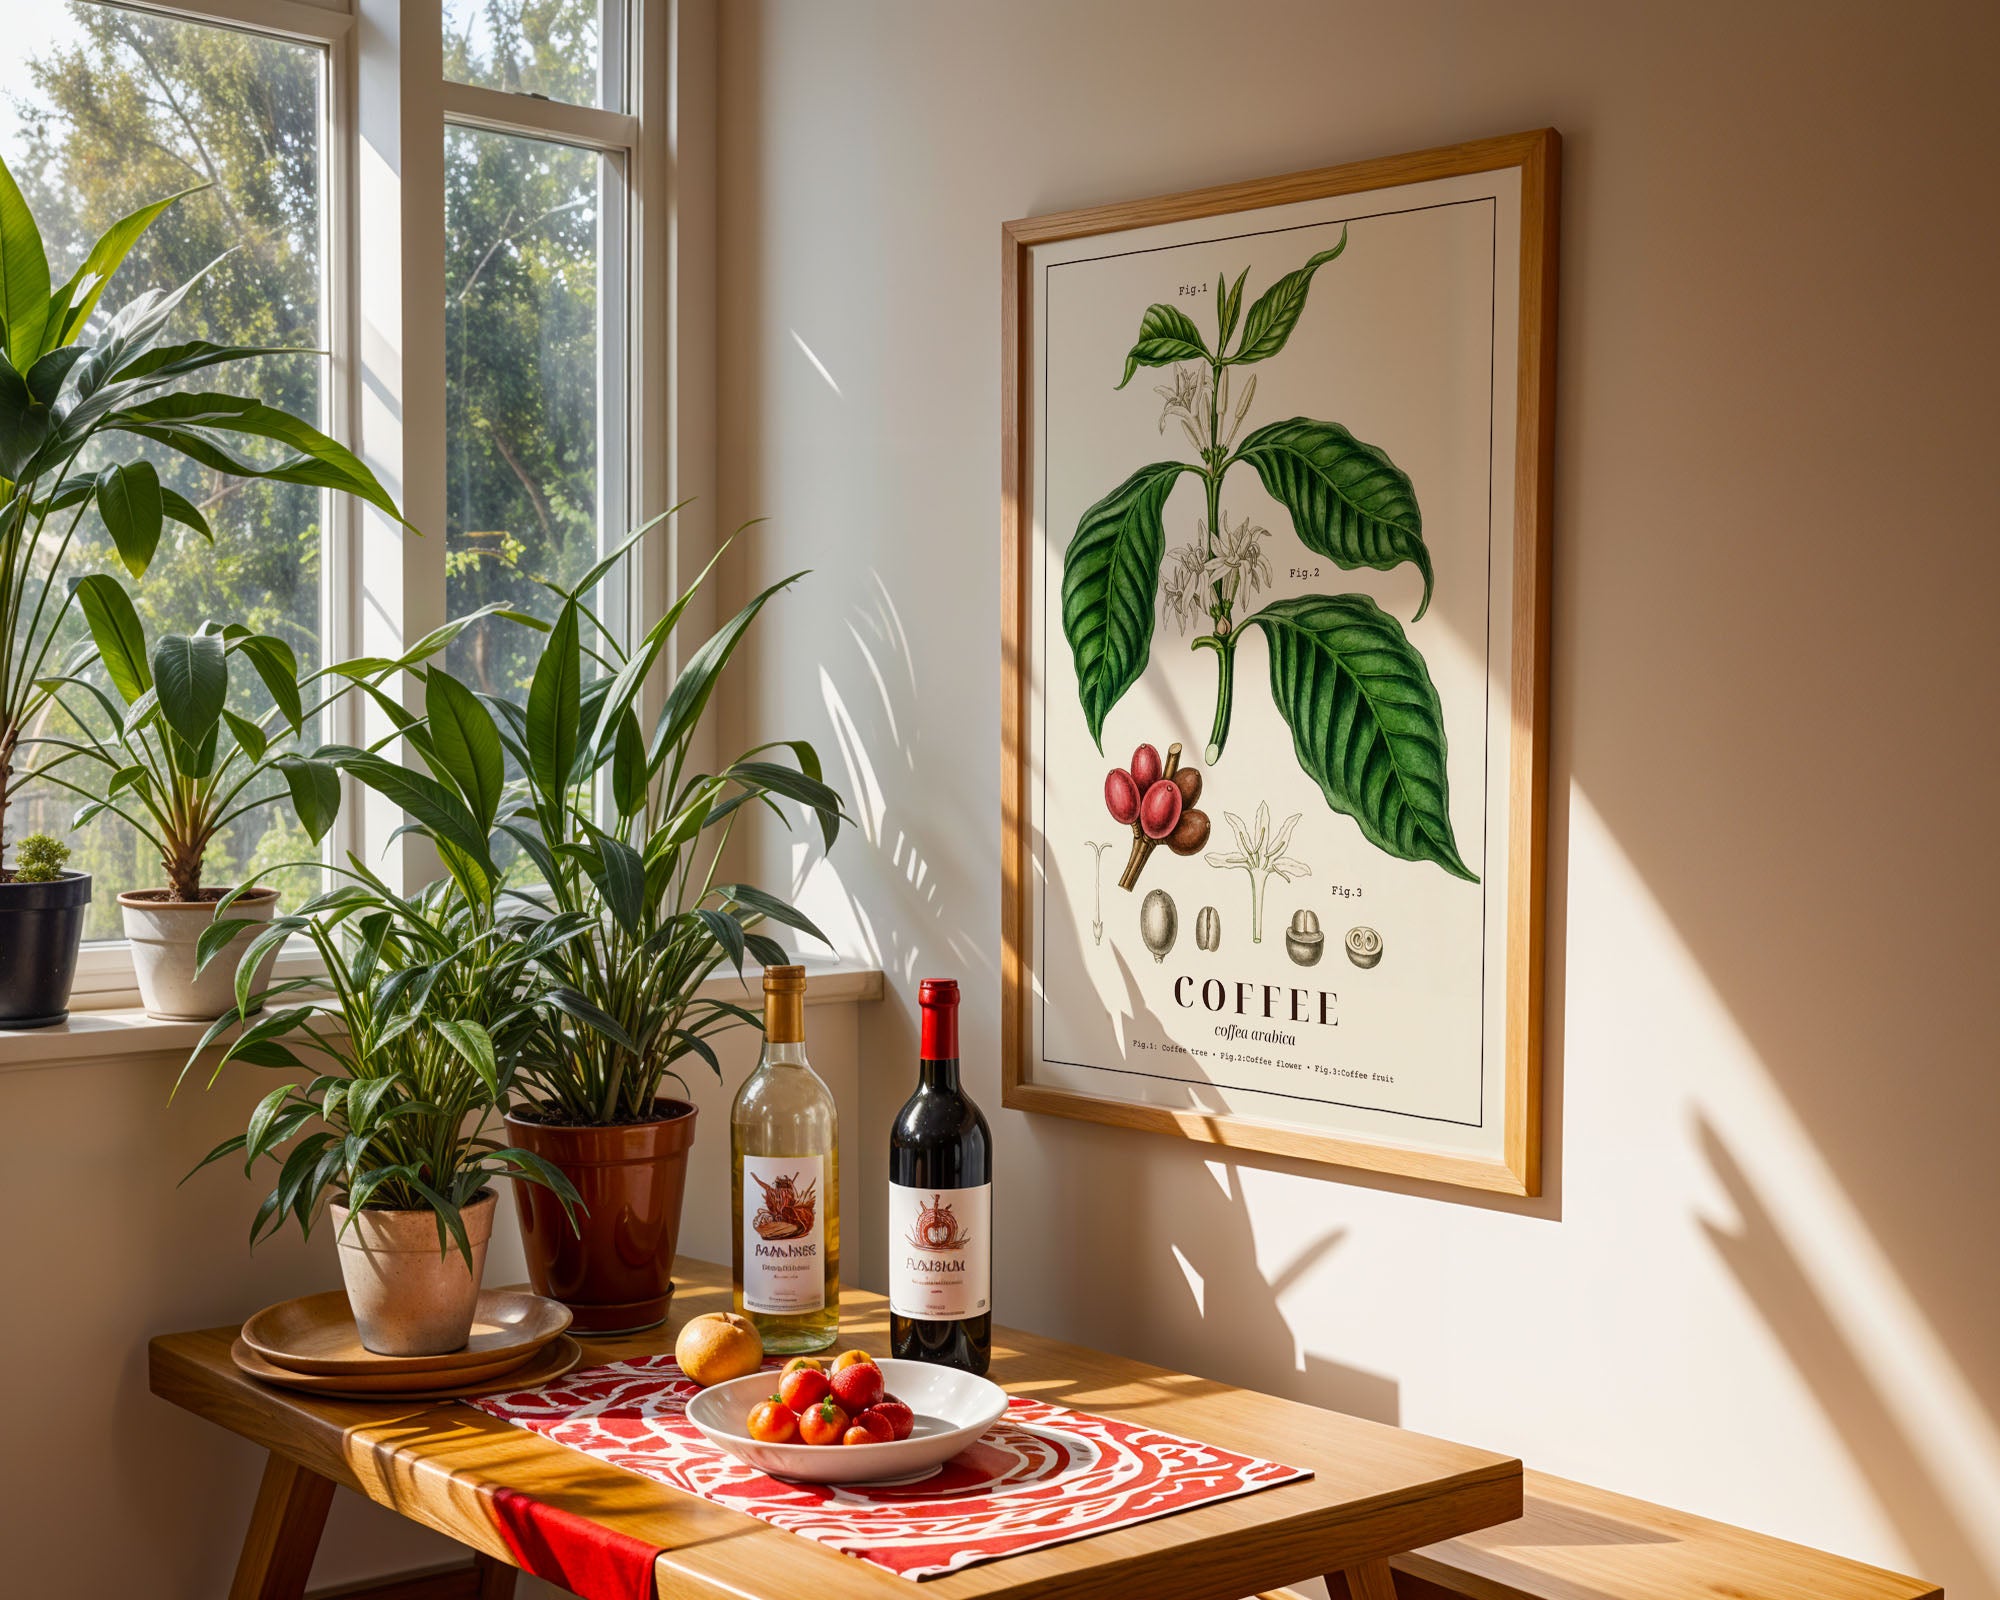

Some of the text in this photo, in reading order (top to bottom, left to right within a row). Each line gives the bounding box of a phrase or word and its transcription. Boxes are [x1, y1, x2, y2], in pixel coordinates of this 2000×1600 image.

[1179, 283, 1207, 296] Fig.1
[1290, 567, 1320, 580] Fig.2
[1331, 885, 1362, 898] Fig.3
[1174, 975, 1339, 1026] COFFEE
[1214, 1023, 1297, 1046] coffea arabica
[1132, 1039, 1158, 1050] Fig.1:
[1161, 1044, 1187, 1054] Coffee
[1191, 1048, 1208, 1057] tree
[1276, 1059, 1303, 1070] flower
[1372, 1072, 1395, 1083] fruit
